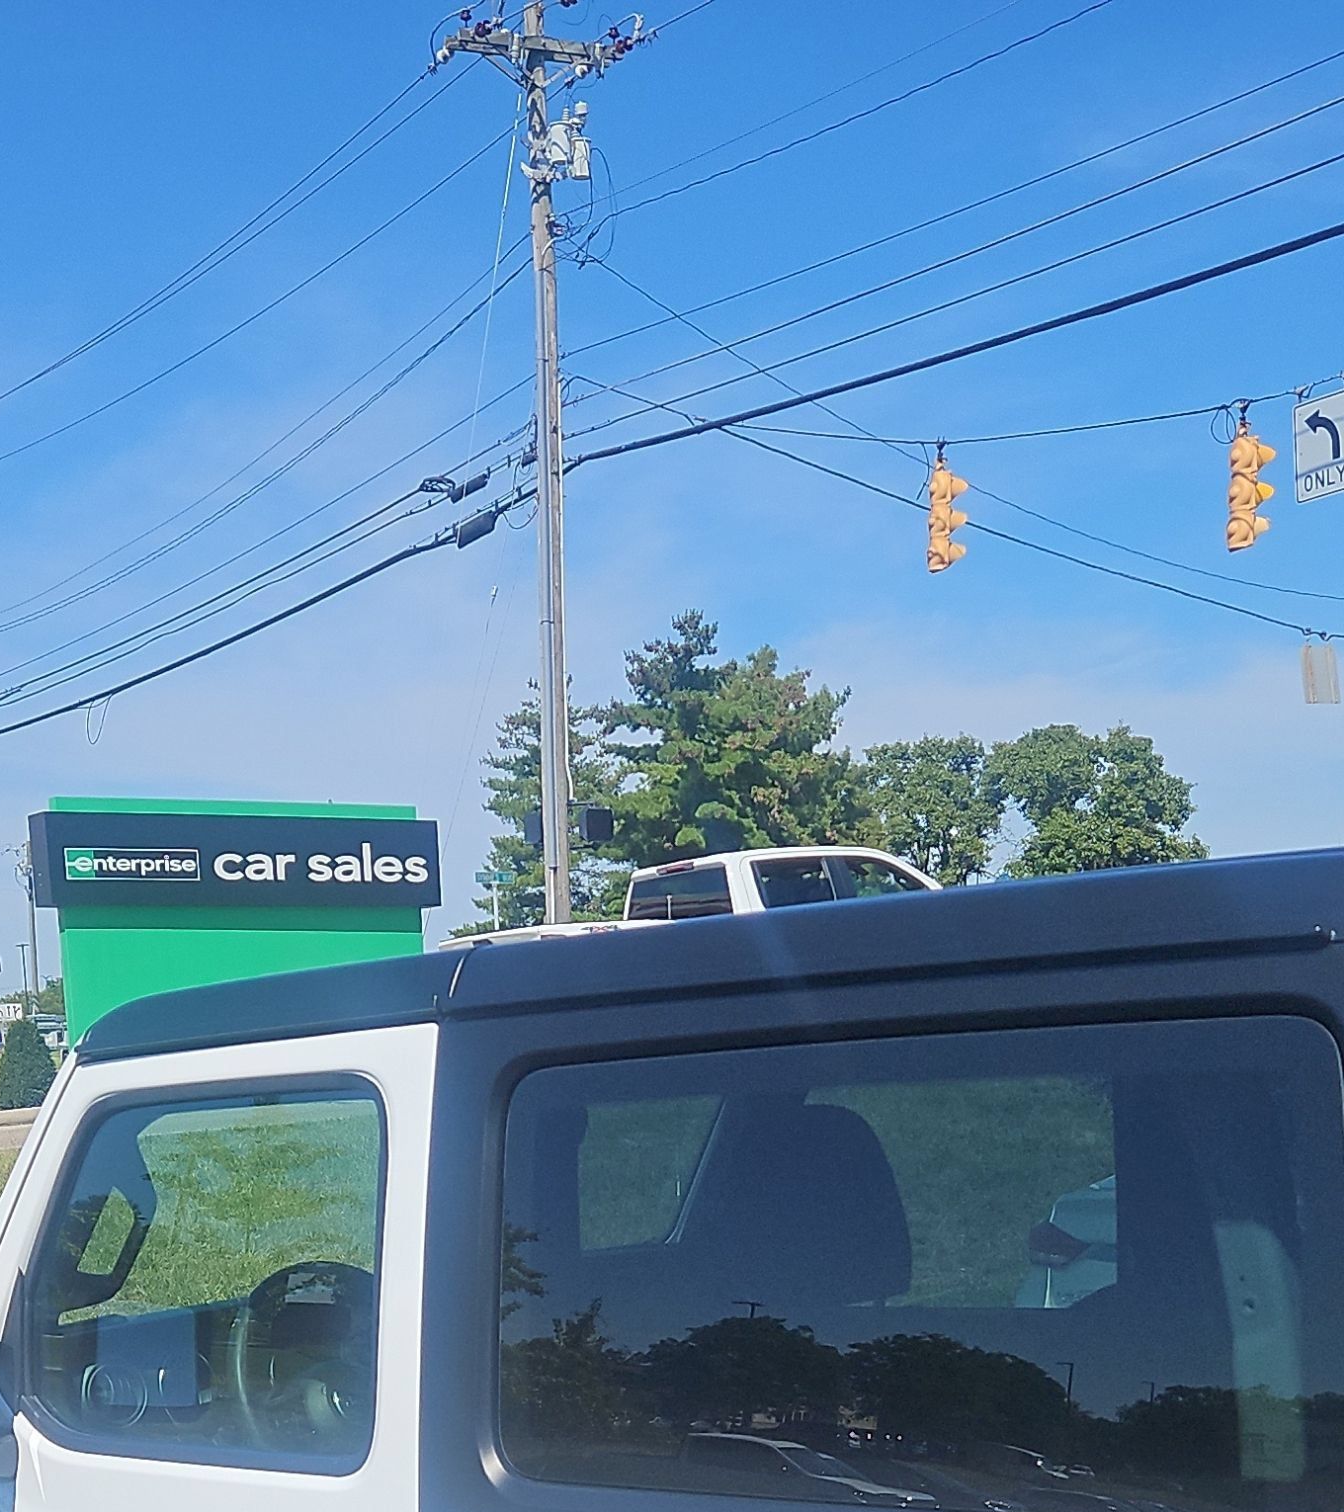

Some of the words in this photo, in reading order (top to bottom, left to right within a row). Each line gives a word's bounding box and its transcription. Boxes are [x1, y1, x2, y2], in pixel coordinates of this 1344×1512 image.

[73, 854, 197, 877] enterprise
[214, 852, 296, 882] car
[307, 842, 429, 883] sales
